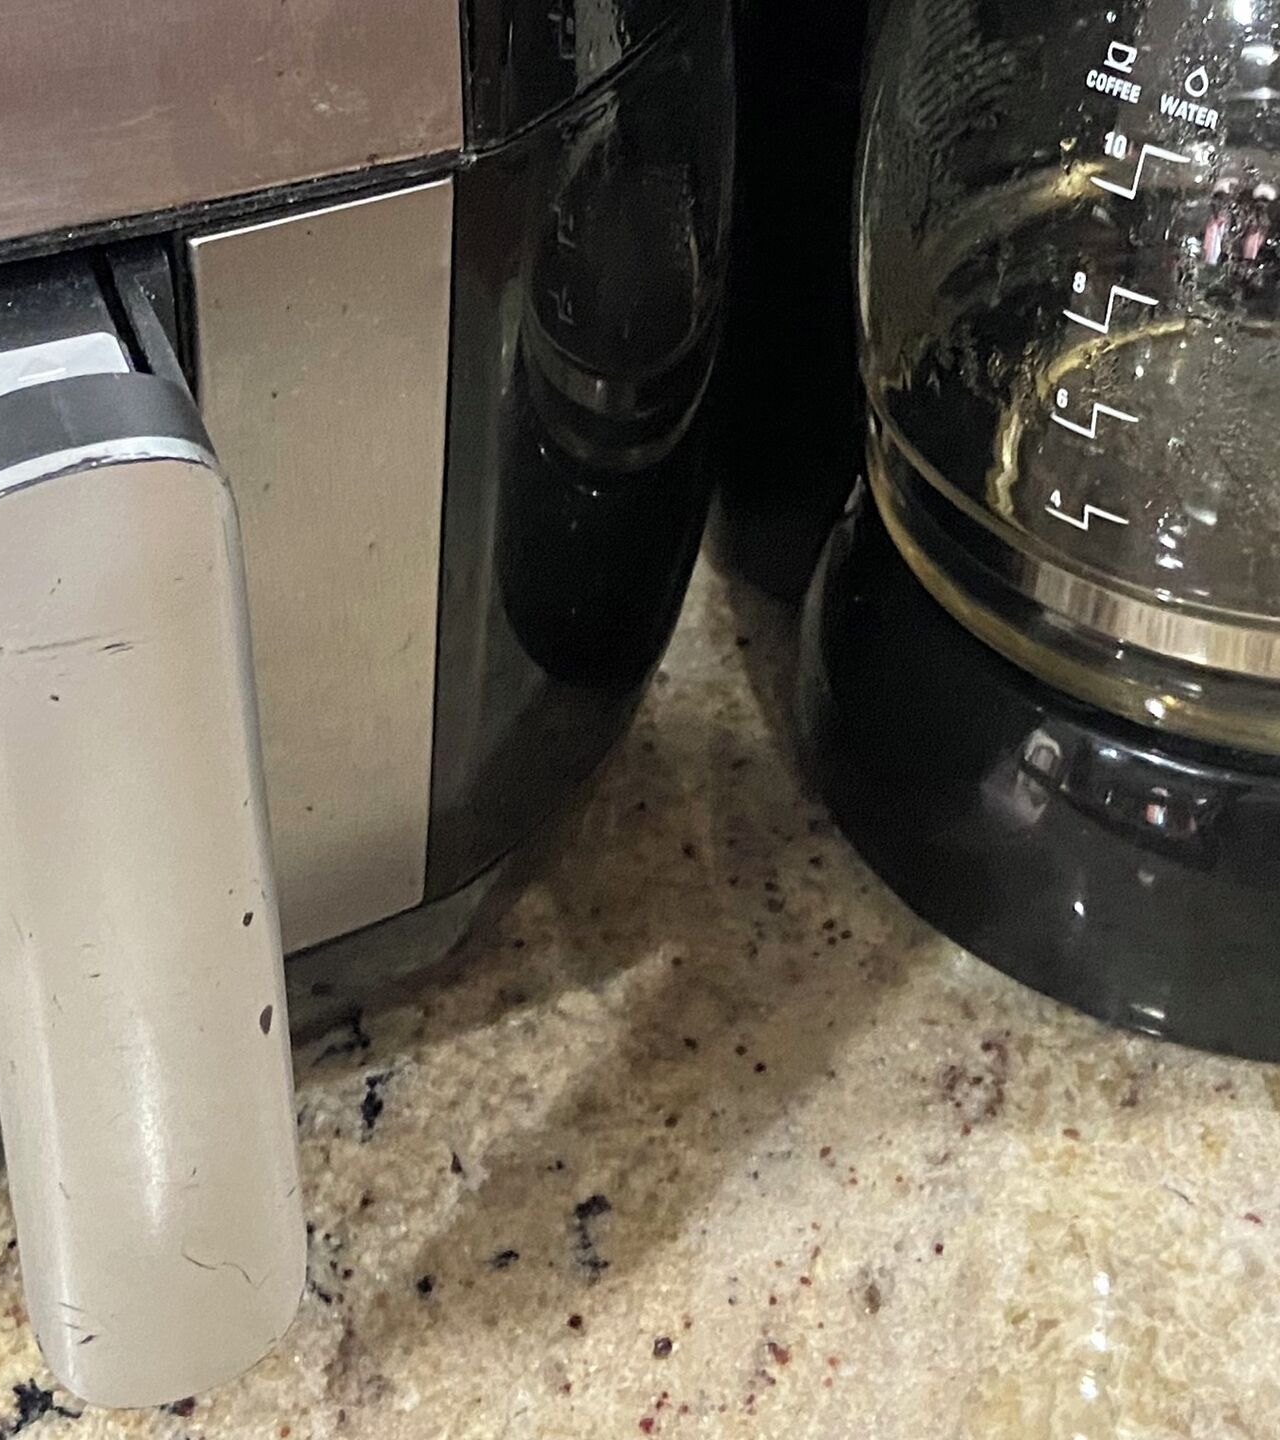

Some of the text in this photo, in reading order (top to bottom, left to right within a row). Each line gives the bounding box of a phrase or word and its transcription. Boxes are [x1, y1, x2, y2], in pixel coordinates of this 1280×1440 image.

[1086, 69, 1142, 104] COFFEE
[1160, 93, 1219, 130] WATER
[1104, 131, 1128, 161] 10
[1073, 271, 1087, 294] 8
[1056, 388, 1069, 409] 6
